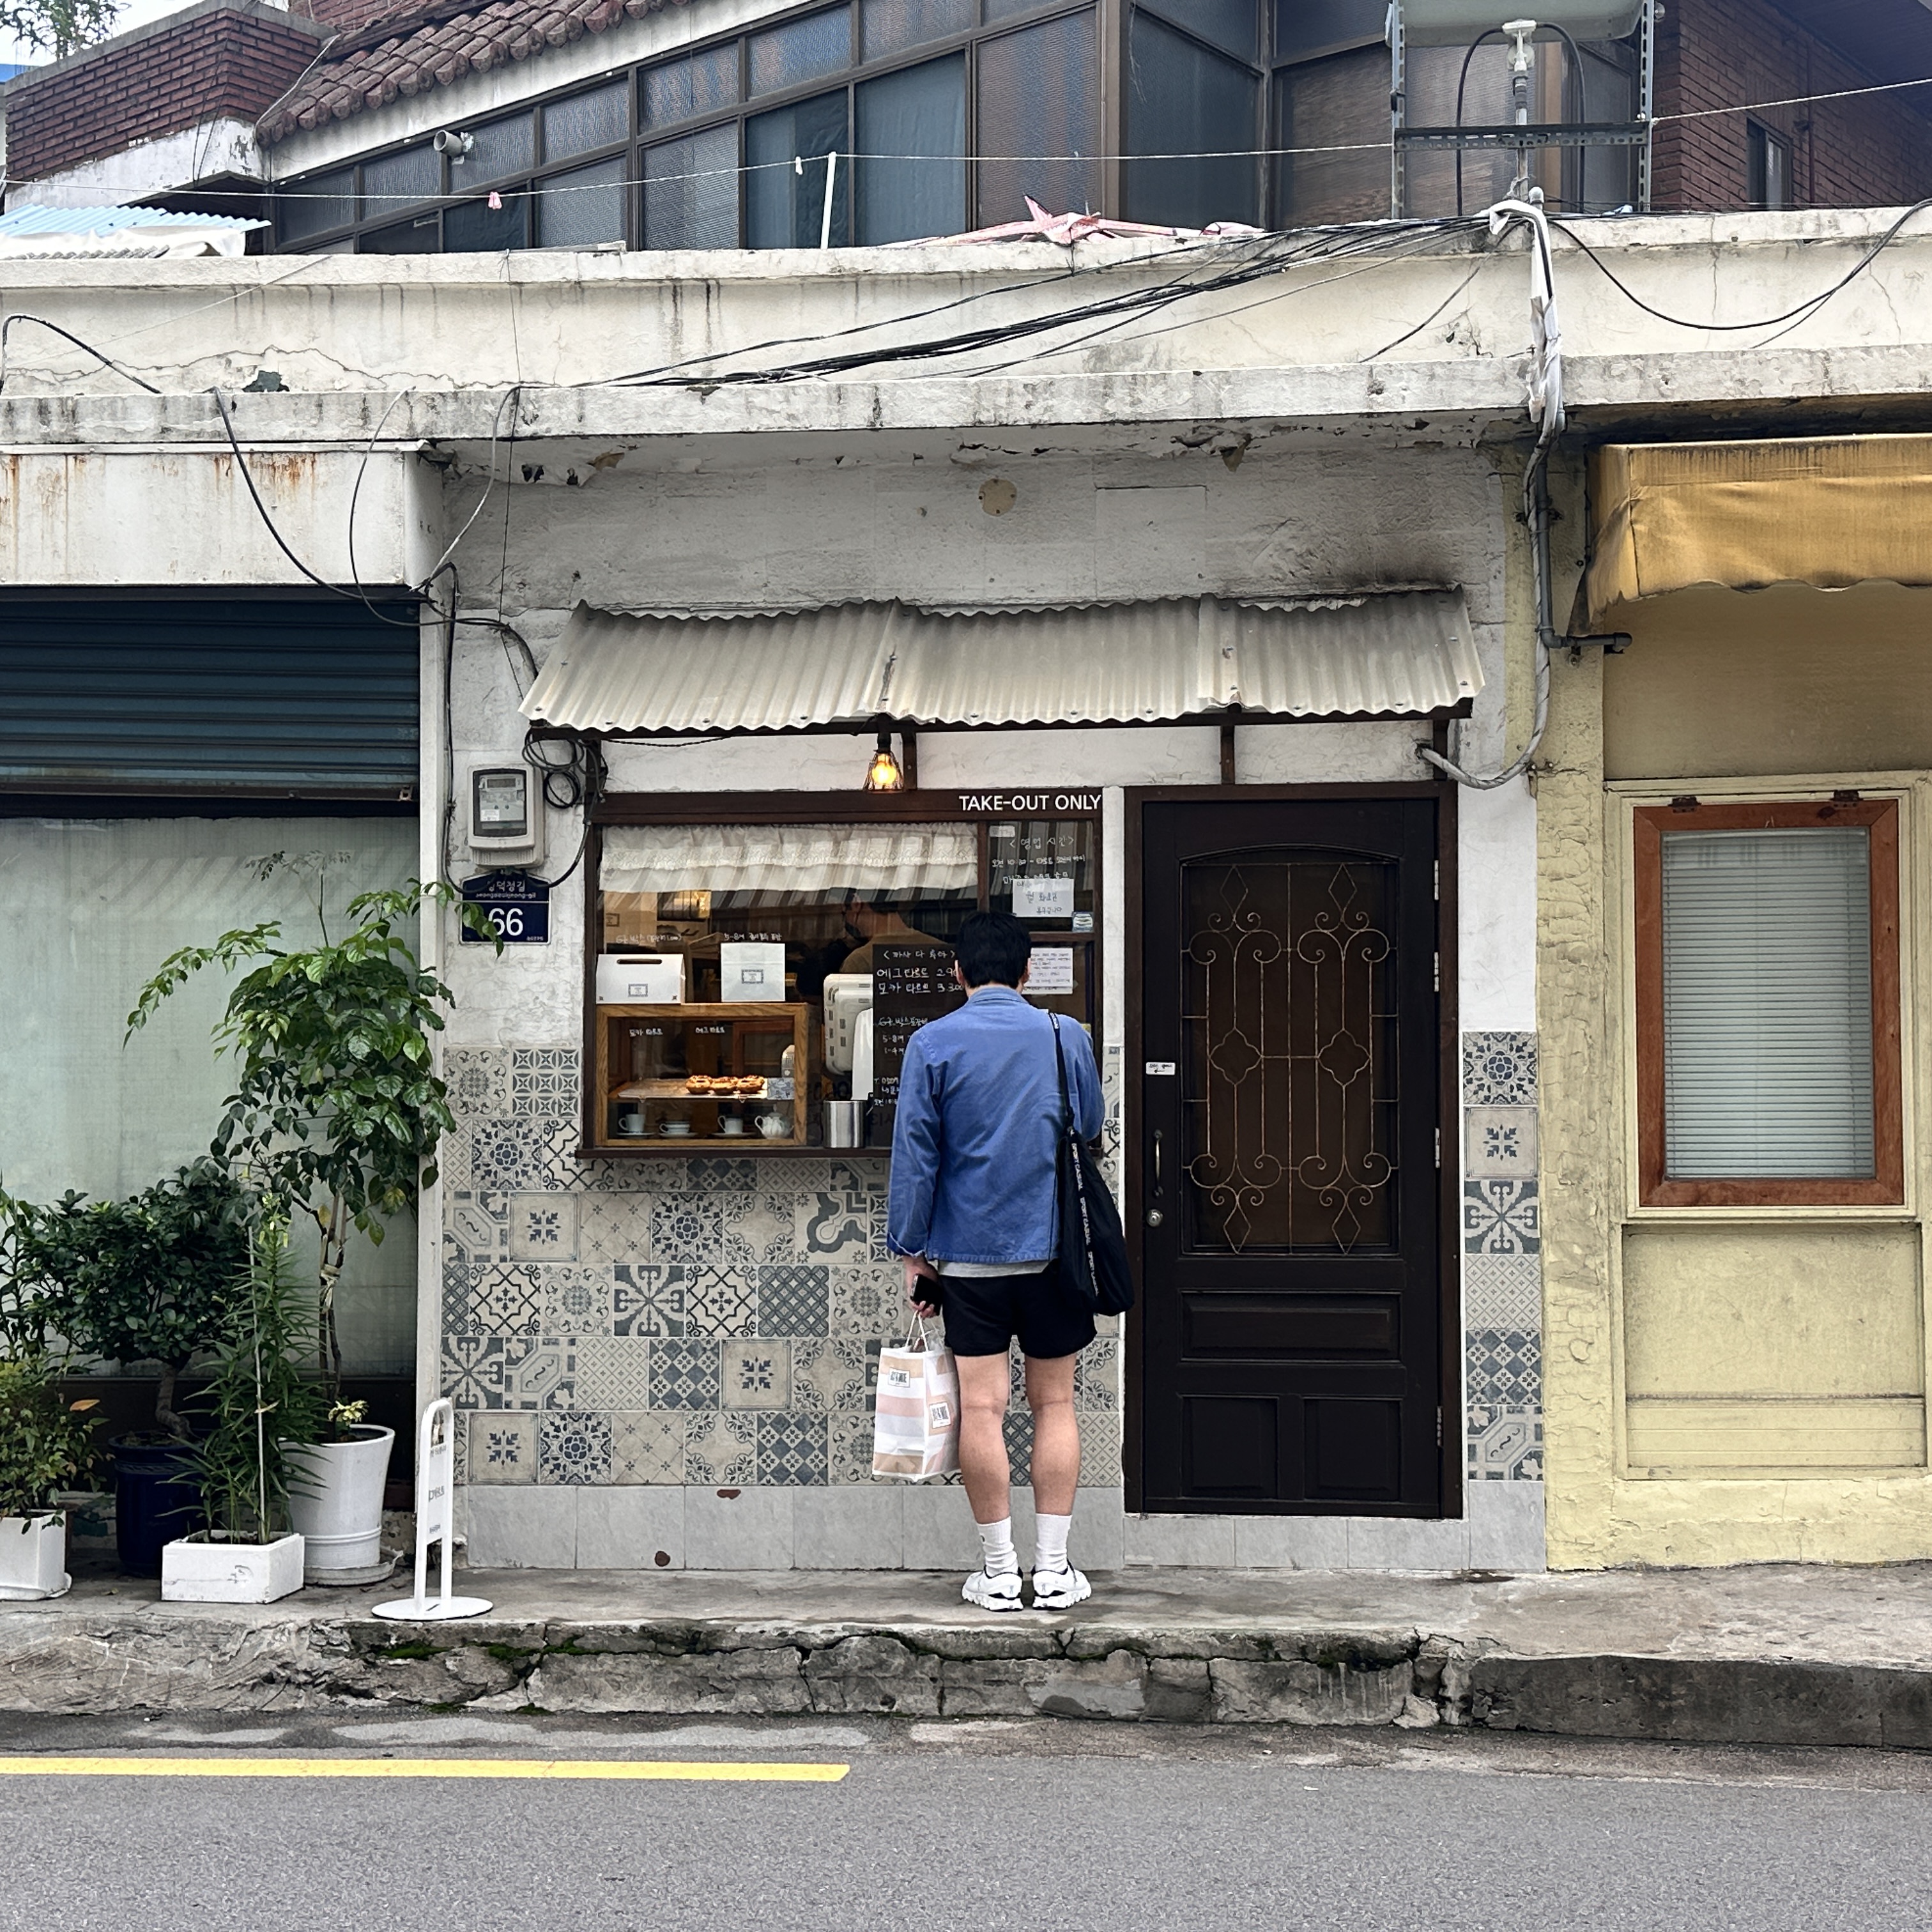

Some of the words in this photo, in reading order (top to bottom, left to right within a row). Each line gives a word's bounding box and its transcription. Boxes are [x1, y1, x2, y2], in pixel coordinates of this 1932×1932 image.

[959, 795, 1050, 811] TAKE-OUT
[1055, 794, 1101, 810] ONLY
[488, 908, 523, 936] 66
